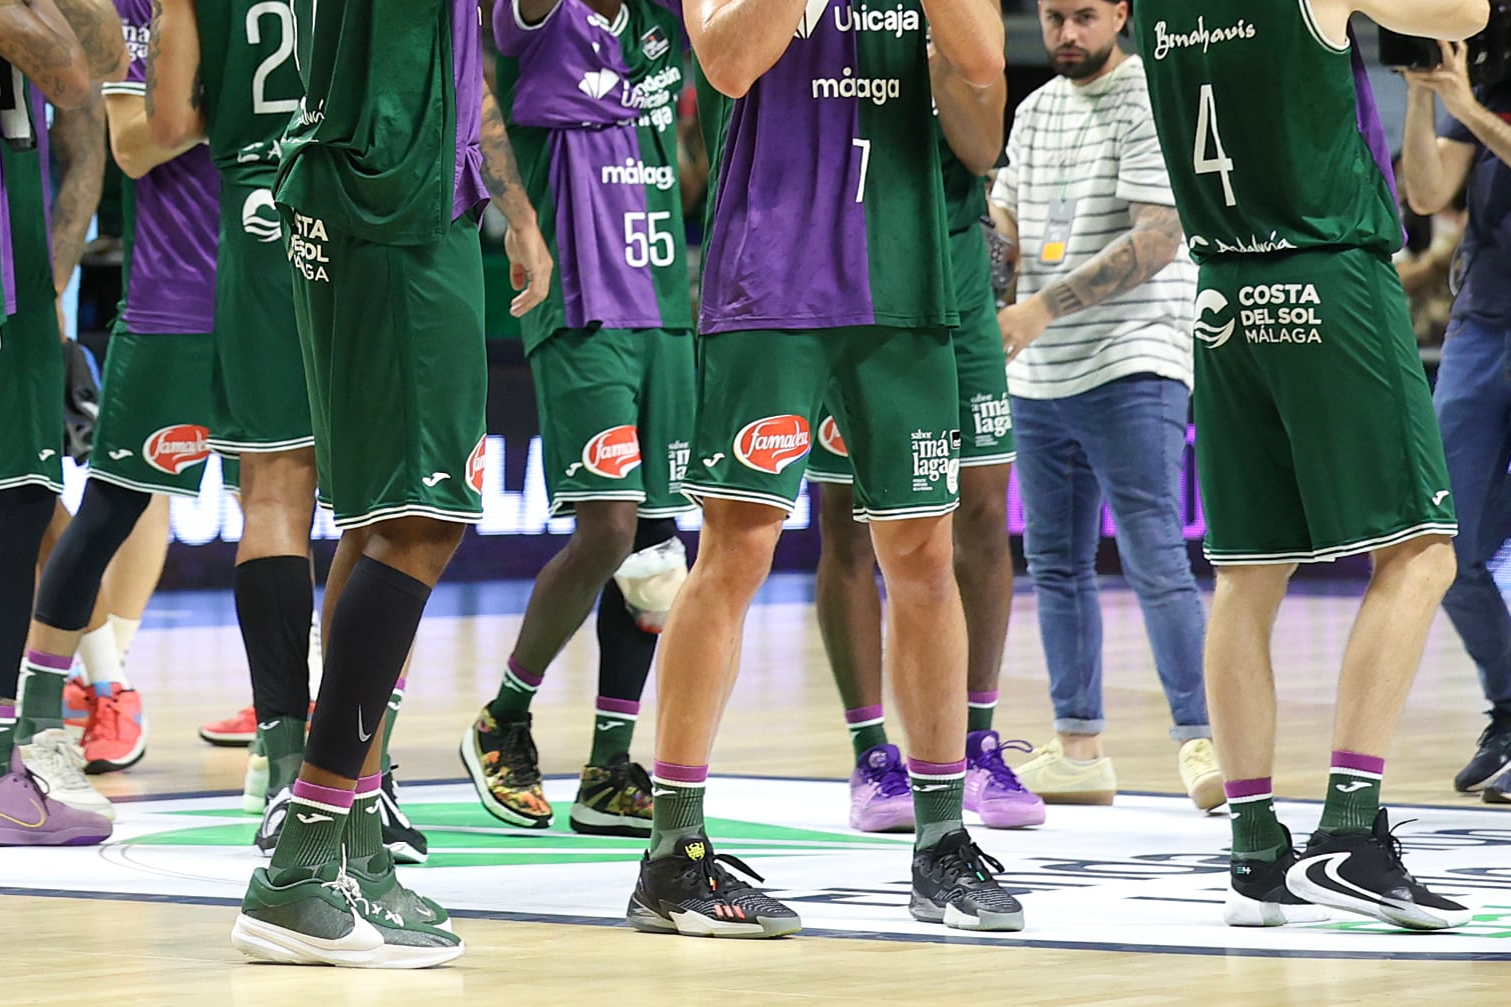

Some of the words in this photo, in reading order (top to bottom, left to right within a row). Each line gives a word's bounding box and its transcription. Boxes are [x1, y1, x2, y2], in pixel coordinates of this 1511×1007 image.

[1193, 83, 1238, 208] 4
[623, 210, 676, 268] 55
[1238, 283, 1322, 307] COSTA
[1240, 308, 1276, 327] DEL
[1277, 307, 1323, 326] SOL
[1244, 324, 1323, 344] MÁLAGA
